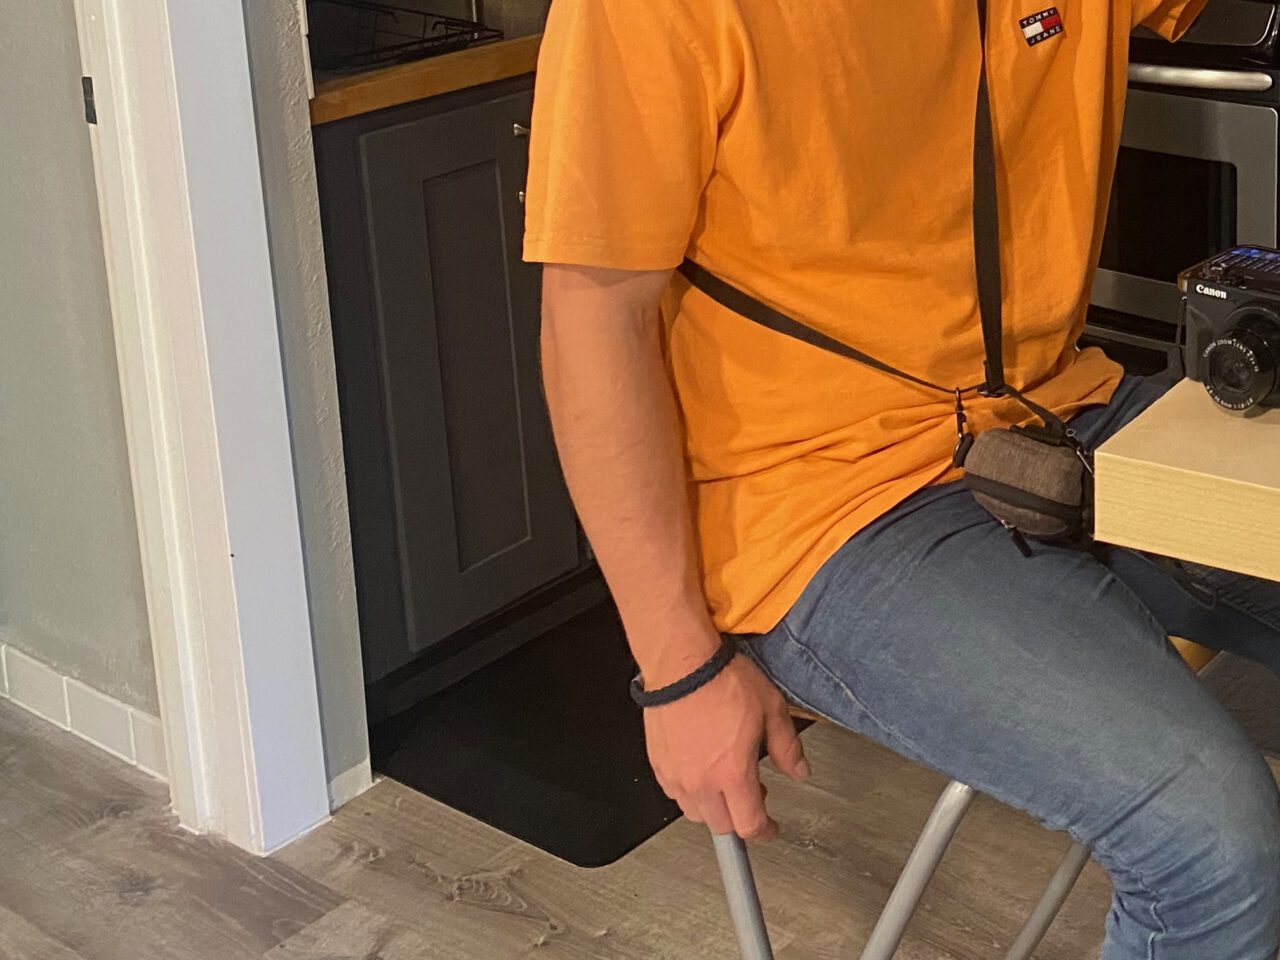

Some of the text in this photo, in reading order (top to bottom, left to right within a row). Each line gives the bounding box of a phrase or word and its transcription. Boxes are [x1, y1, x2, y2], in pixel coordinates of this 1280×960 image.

[1022, 9, 1054, 26] TOMMY
[1030, 25, 1061, 44] JEANS
[1195, 284, 1227, 299] Canon
